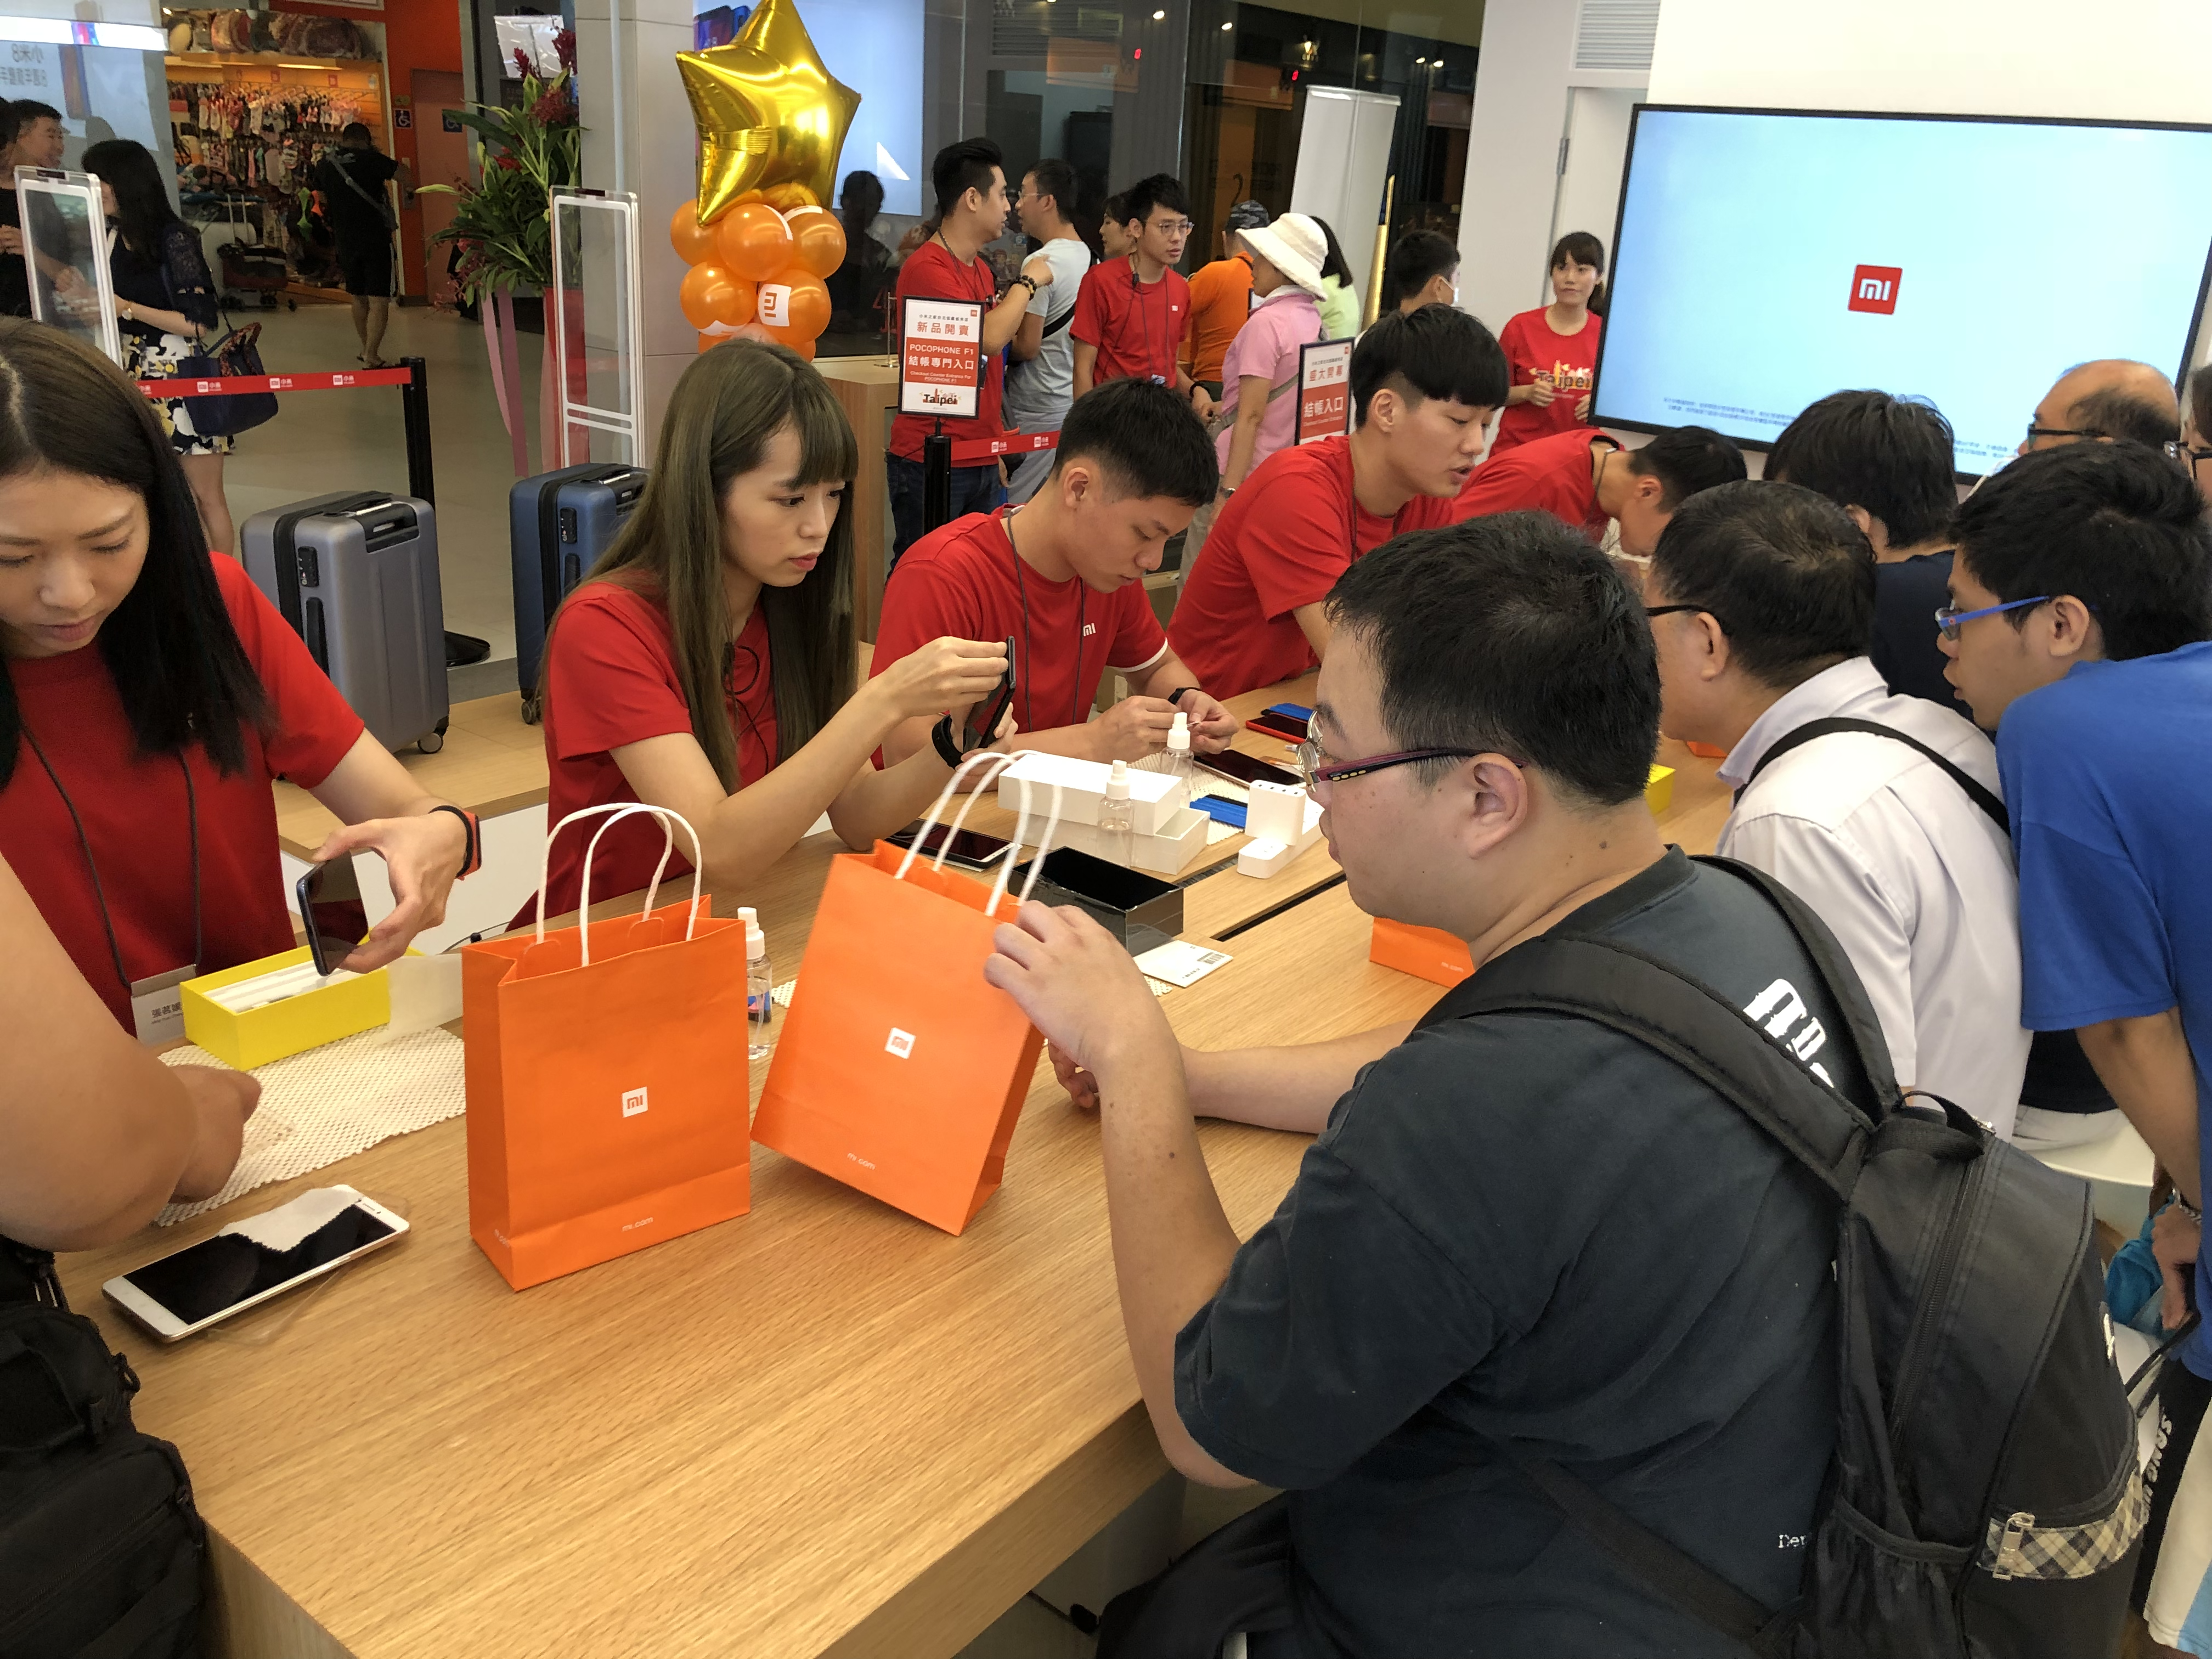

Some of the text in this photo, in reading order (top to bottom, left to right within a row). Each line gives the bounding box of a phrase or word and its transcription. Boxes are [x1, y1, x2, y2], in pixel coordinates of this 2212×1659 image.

[917, 321, 969, 336] 新品開賣
[910, 344, 961, 354] POCOPHONE
[908, 356, 974, 370] 結帳專門入口
[924, 394, 957, 406] Taipei
